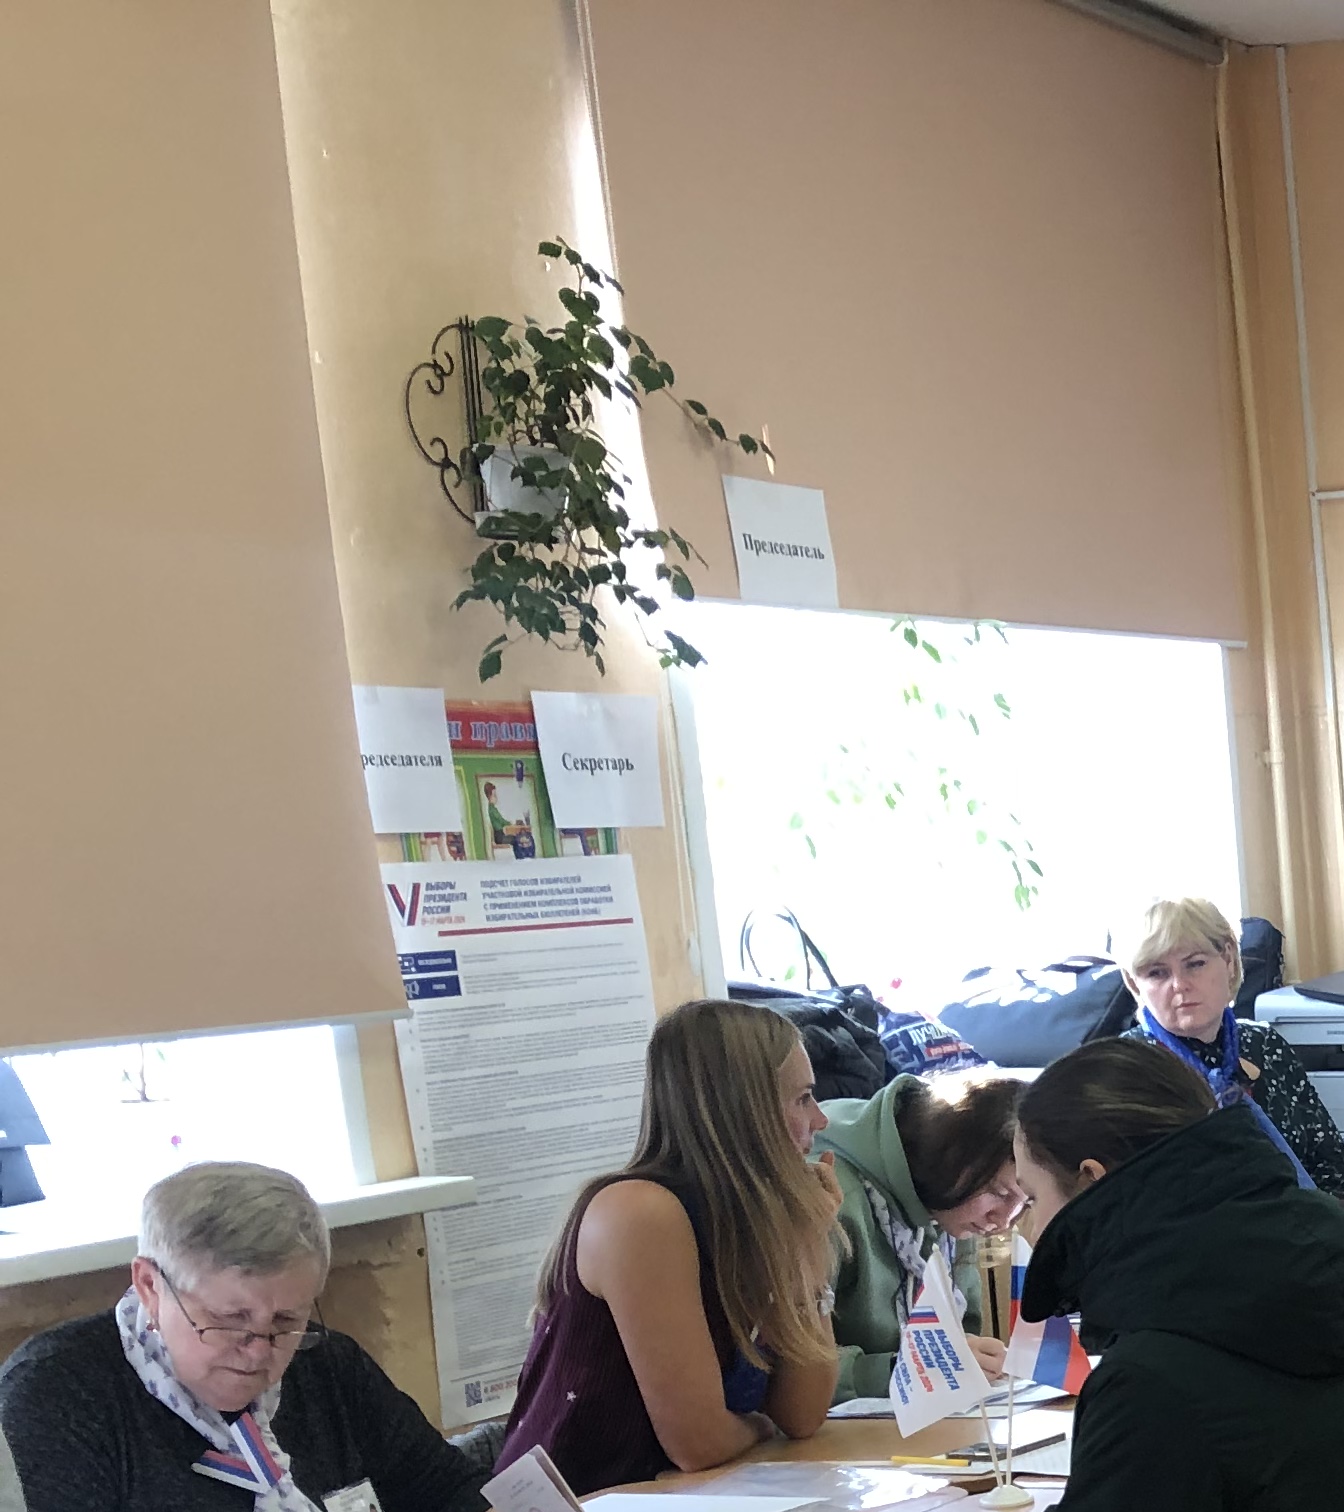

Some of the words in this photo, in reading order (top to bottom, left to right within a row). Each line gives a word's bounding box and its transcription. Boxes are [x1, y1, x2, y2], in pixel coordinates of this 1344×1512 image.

[742, 532, 825, 560] Председатель
[361, 754, 443, 769] редседателя
[561, 752, 635, 776] Секретарь
